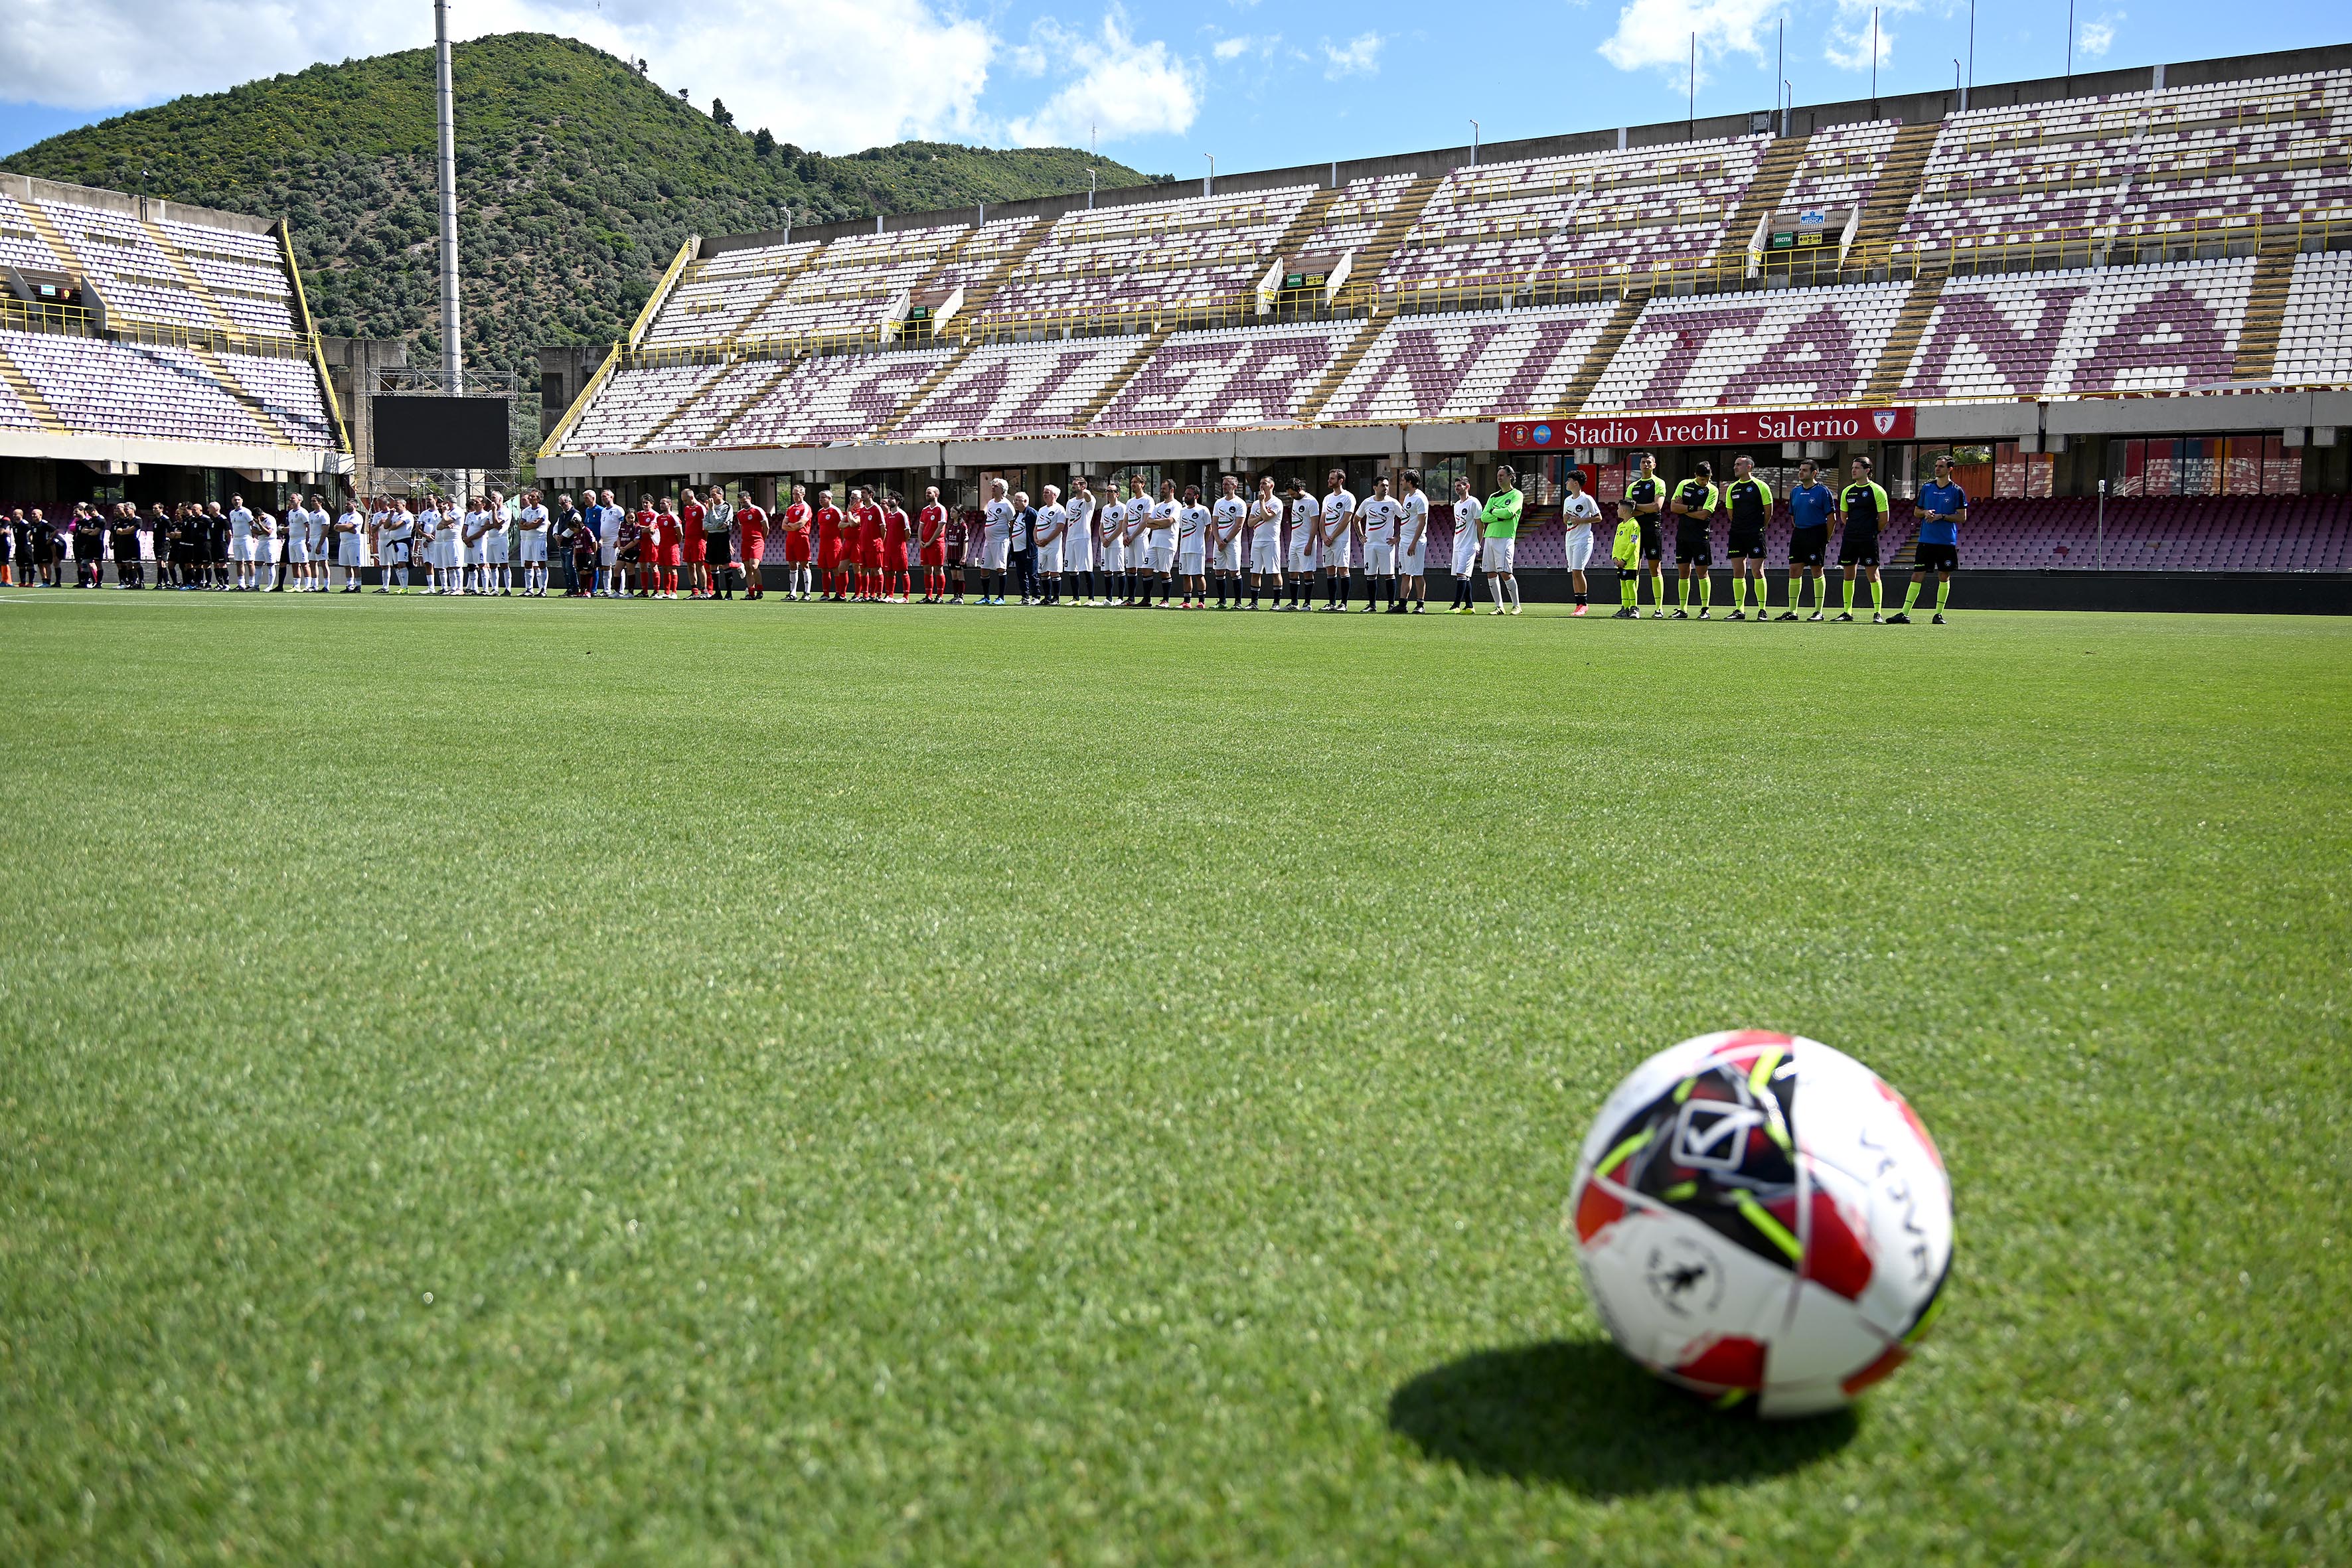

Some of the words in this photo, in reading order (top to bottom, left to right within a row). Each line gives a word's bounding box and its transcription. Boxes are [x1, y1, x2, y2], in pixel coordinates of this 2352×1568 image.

[1565, 422, 1638, 445] Stadio
[1646, 418, 1729, 443] Arechi
[1758, 415, 1858, 439] Salerno
